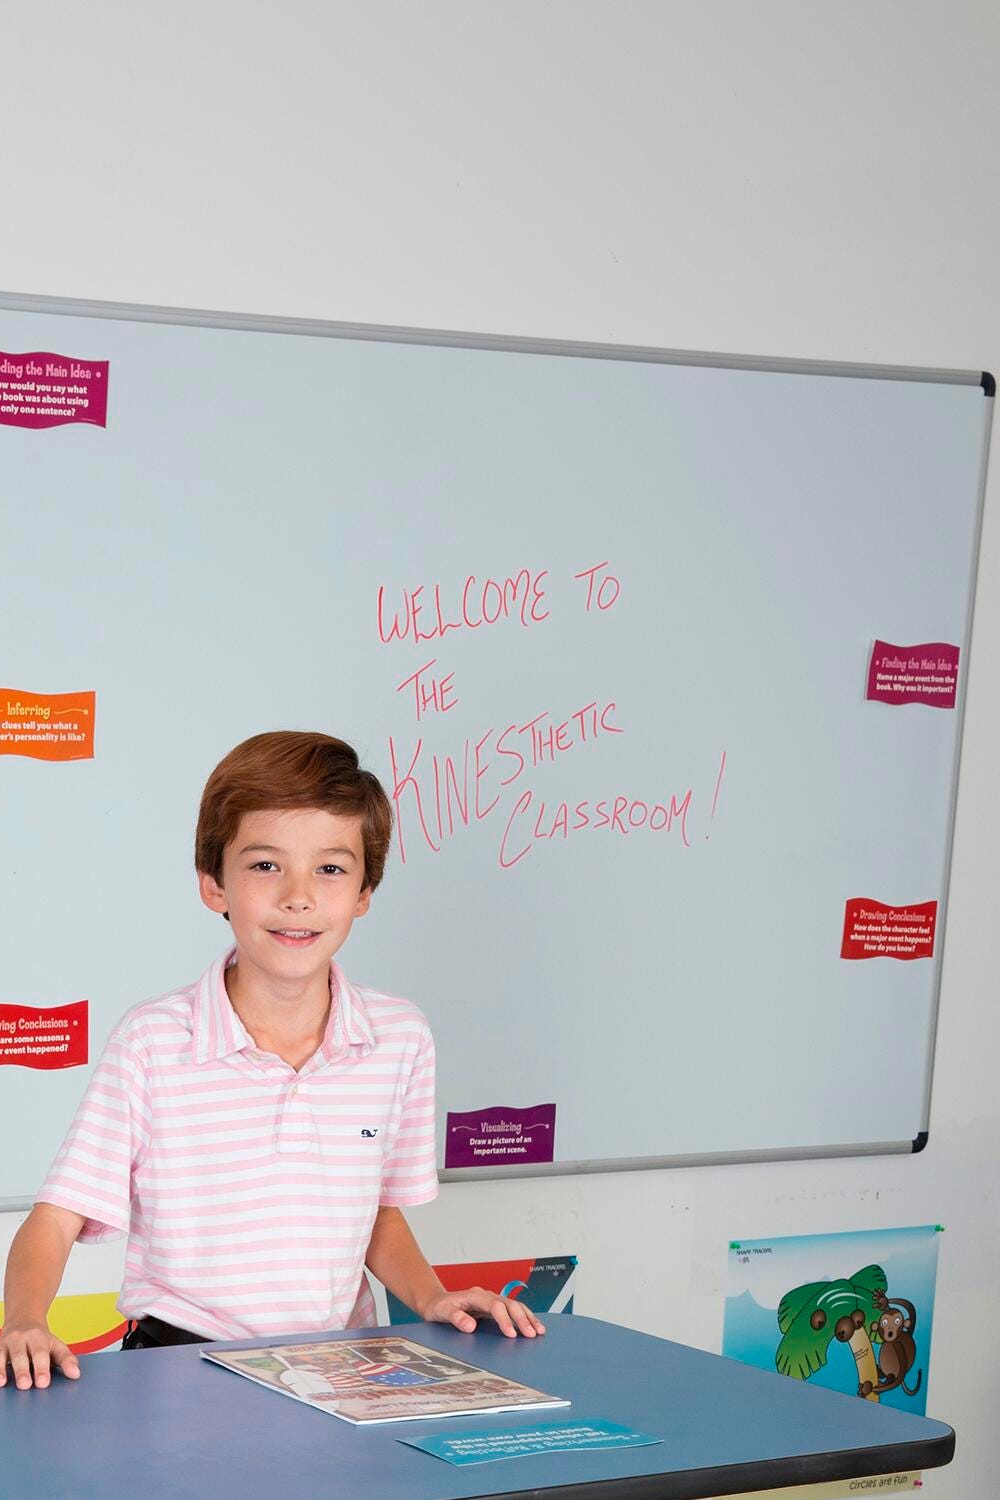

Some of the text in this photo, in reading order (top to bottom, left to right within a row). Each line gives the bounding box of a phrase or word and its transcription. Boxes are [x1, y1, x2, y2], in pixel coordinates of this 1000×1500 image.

[25, 361, 42, 375] the
[46, 364, 67, 377] Main
[70, 364, 91, 379] Idea
[10, 381, 34, 391] would
[36, 384, 51, 392] you
[52, 385, 66, 394] say
[67, 385, 88, 394] what
[3, 392, 23, 402] book
[25, 395, 40, 403] was
[41, 395, 65, 404] about
[67, 397, 89, 408] using
[1, 404, 75, 417] only one sentence?
[378, 561, 620, 643] WELCOME TO
[397, 659, 458, 721] THE
[7, 702, 50, 720] Inferring
[2, 721, 21, 729] clues
[23, 721, 35, 729] tell
[36, 723, 51, 731] you
[15, 733, 59, 743] personality
[60, 733, 66, 741] is
[67, 733, 86, 741] like?
[389, 702, 624, 864] KINESTHETIC
[19, 1016, 68, 1030] Conclusions
[27, 1044, 68, 1055] happened?
[480, 1120, 522, 1135] Visualizing
[493, 1137, 514, 1146] picture
[474, 1147, 505, 1155] important
[878, 1477, 892, 1487] are
[894, 1475, 908, 1487] fun
